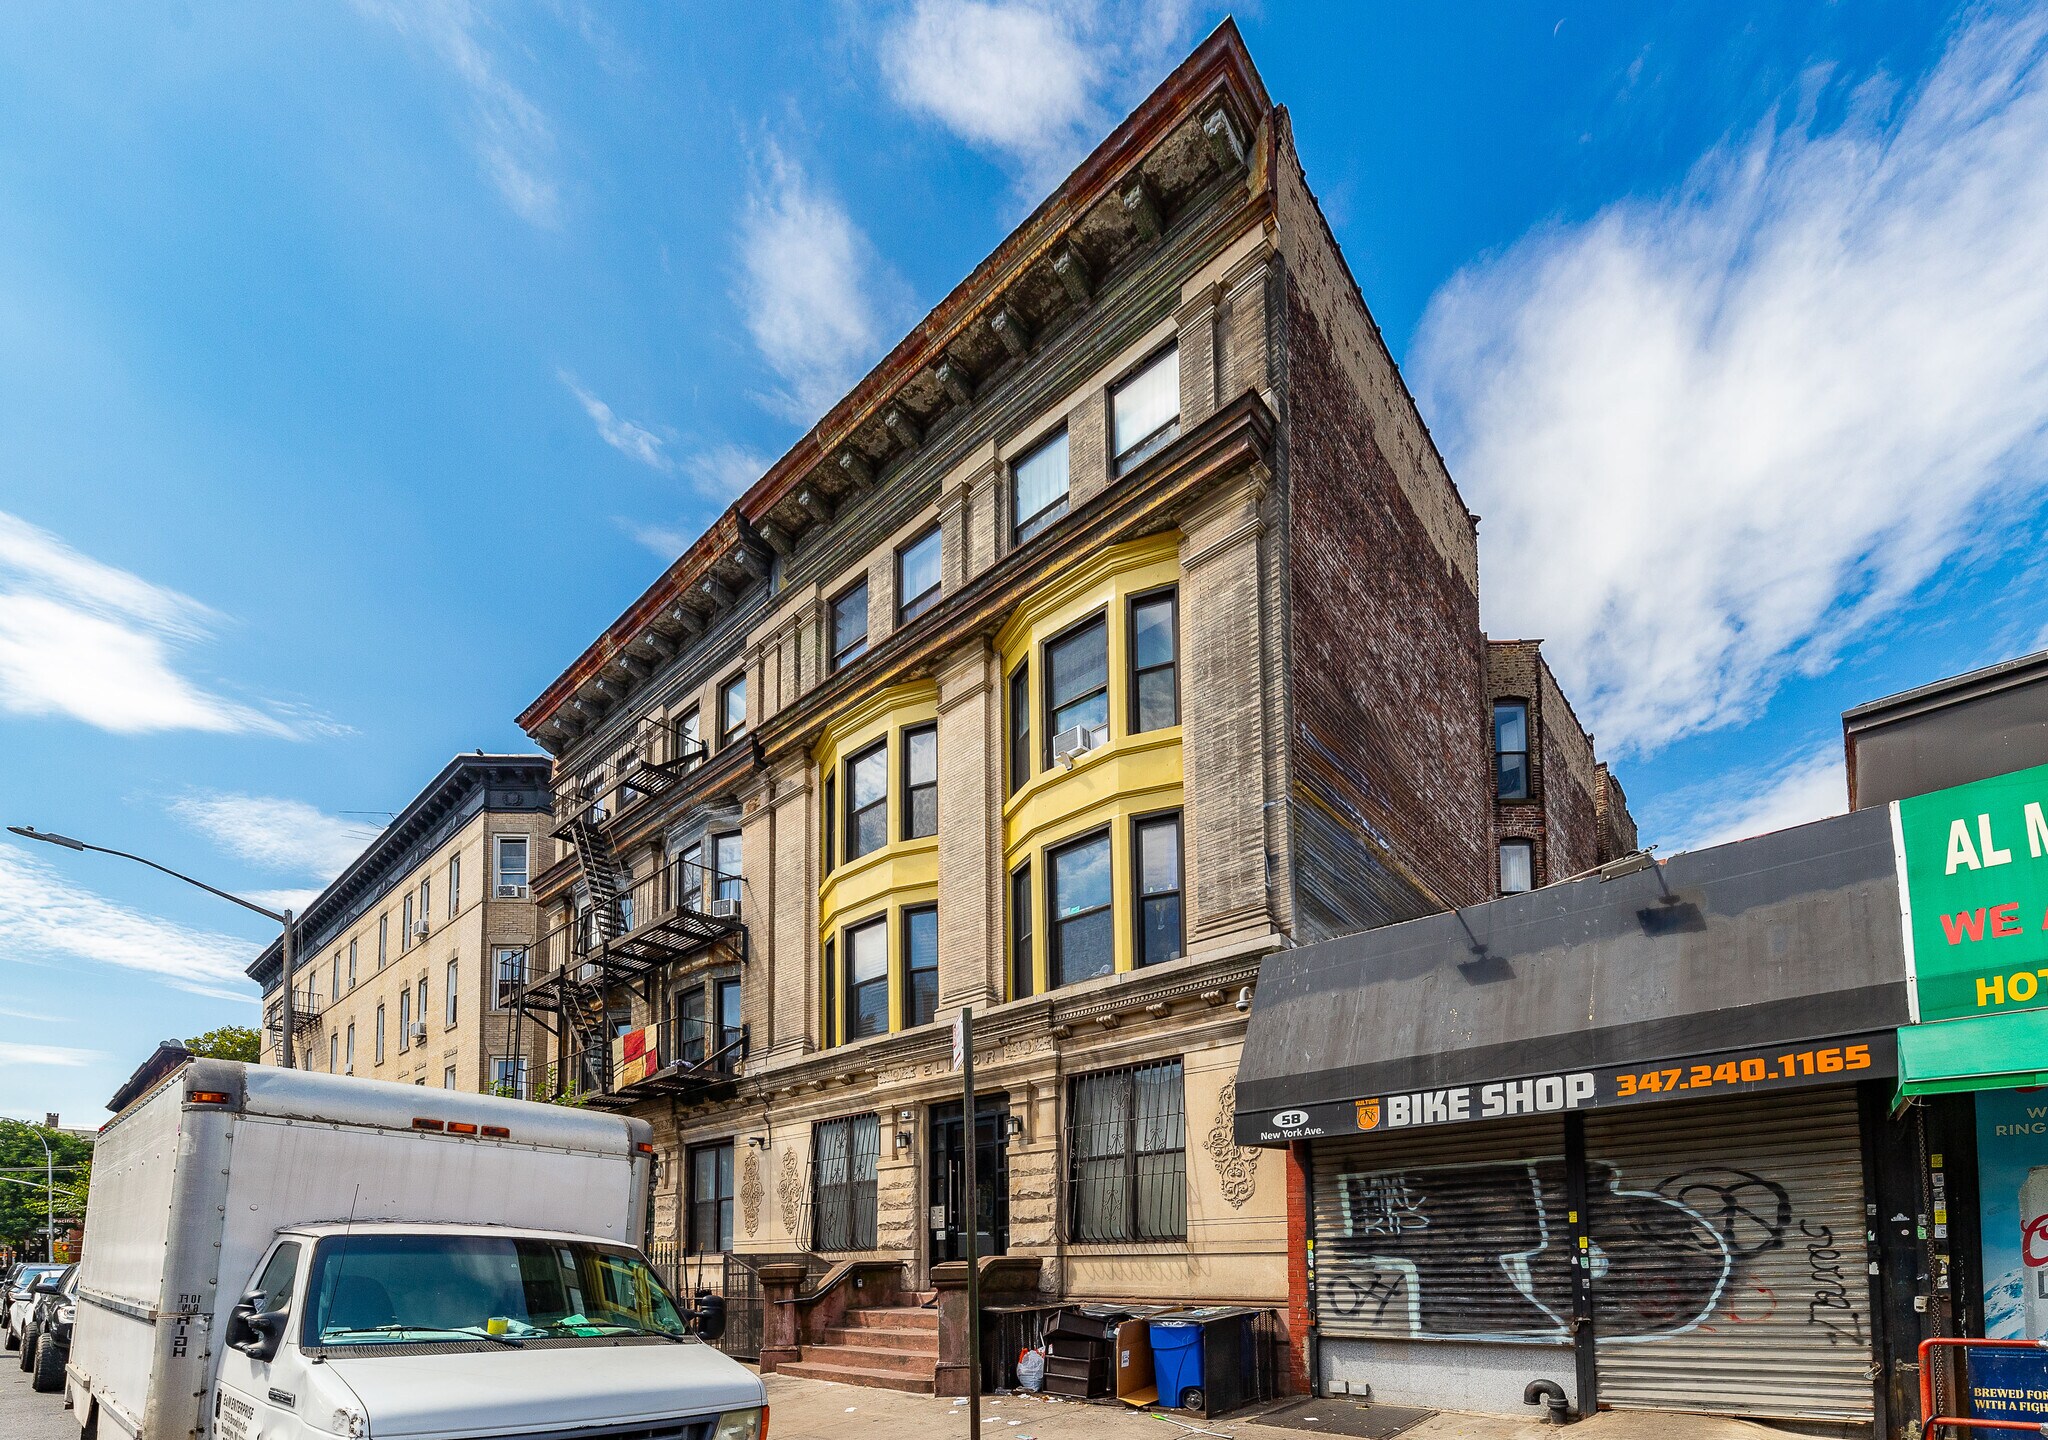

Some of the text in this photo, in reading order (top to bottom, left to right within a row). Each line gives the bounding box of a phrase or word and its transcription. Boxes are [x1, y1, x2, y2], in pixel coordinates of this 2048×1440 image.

[1944, 812, 2013, 876] AL
[1939, 901, 2023, 946] WE
[923, 1049, 996, 1077] ELIOR
[1616, 1044, 1872, 1097] 347.240.1165
[1355, 1097, 1380, 1107] KULTURE
[1387, 1072, 1595, 1127] BIKE SHOP
[1281, 1113, 1301, 1126] 58
[1260, 1127, 1325, 1140] New York Ave.
[1973, 1387, 2025, 1399] BREWED
[231, 1397, 255, 1420] ENTERPRISE
[1974, 1399, 2007, 1410] WITH
[2008, 1401, 2018, 1411] A
